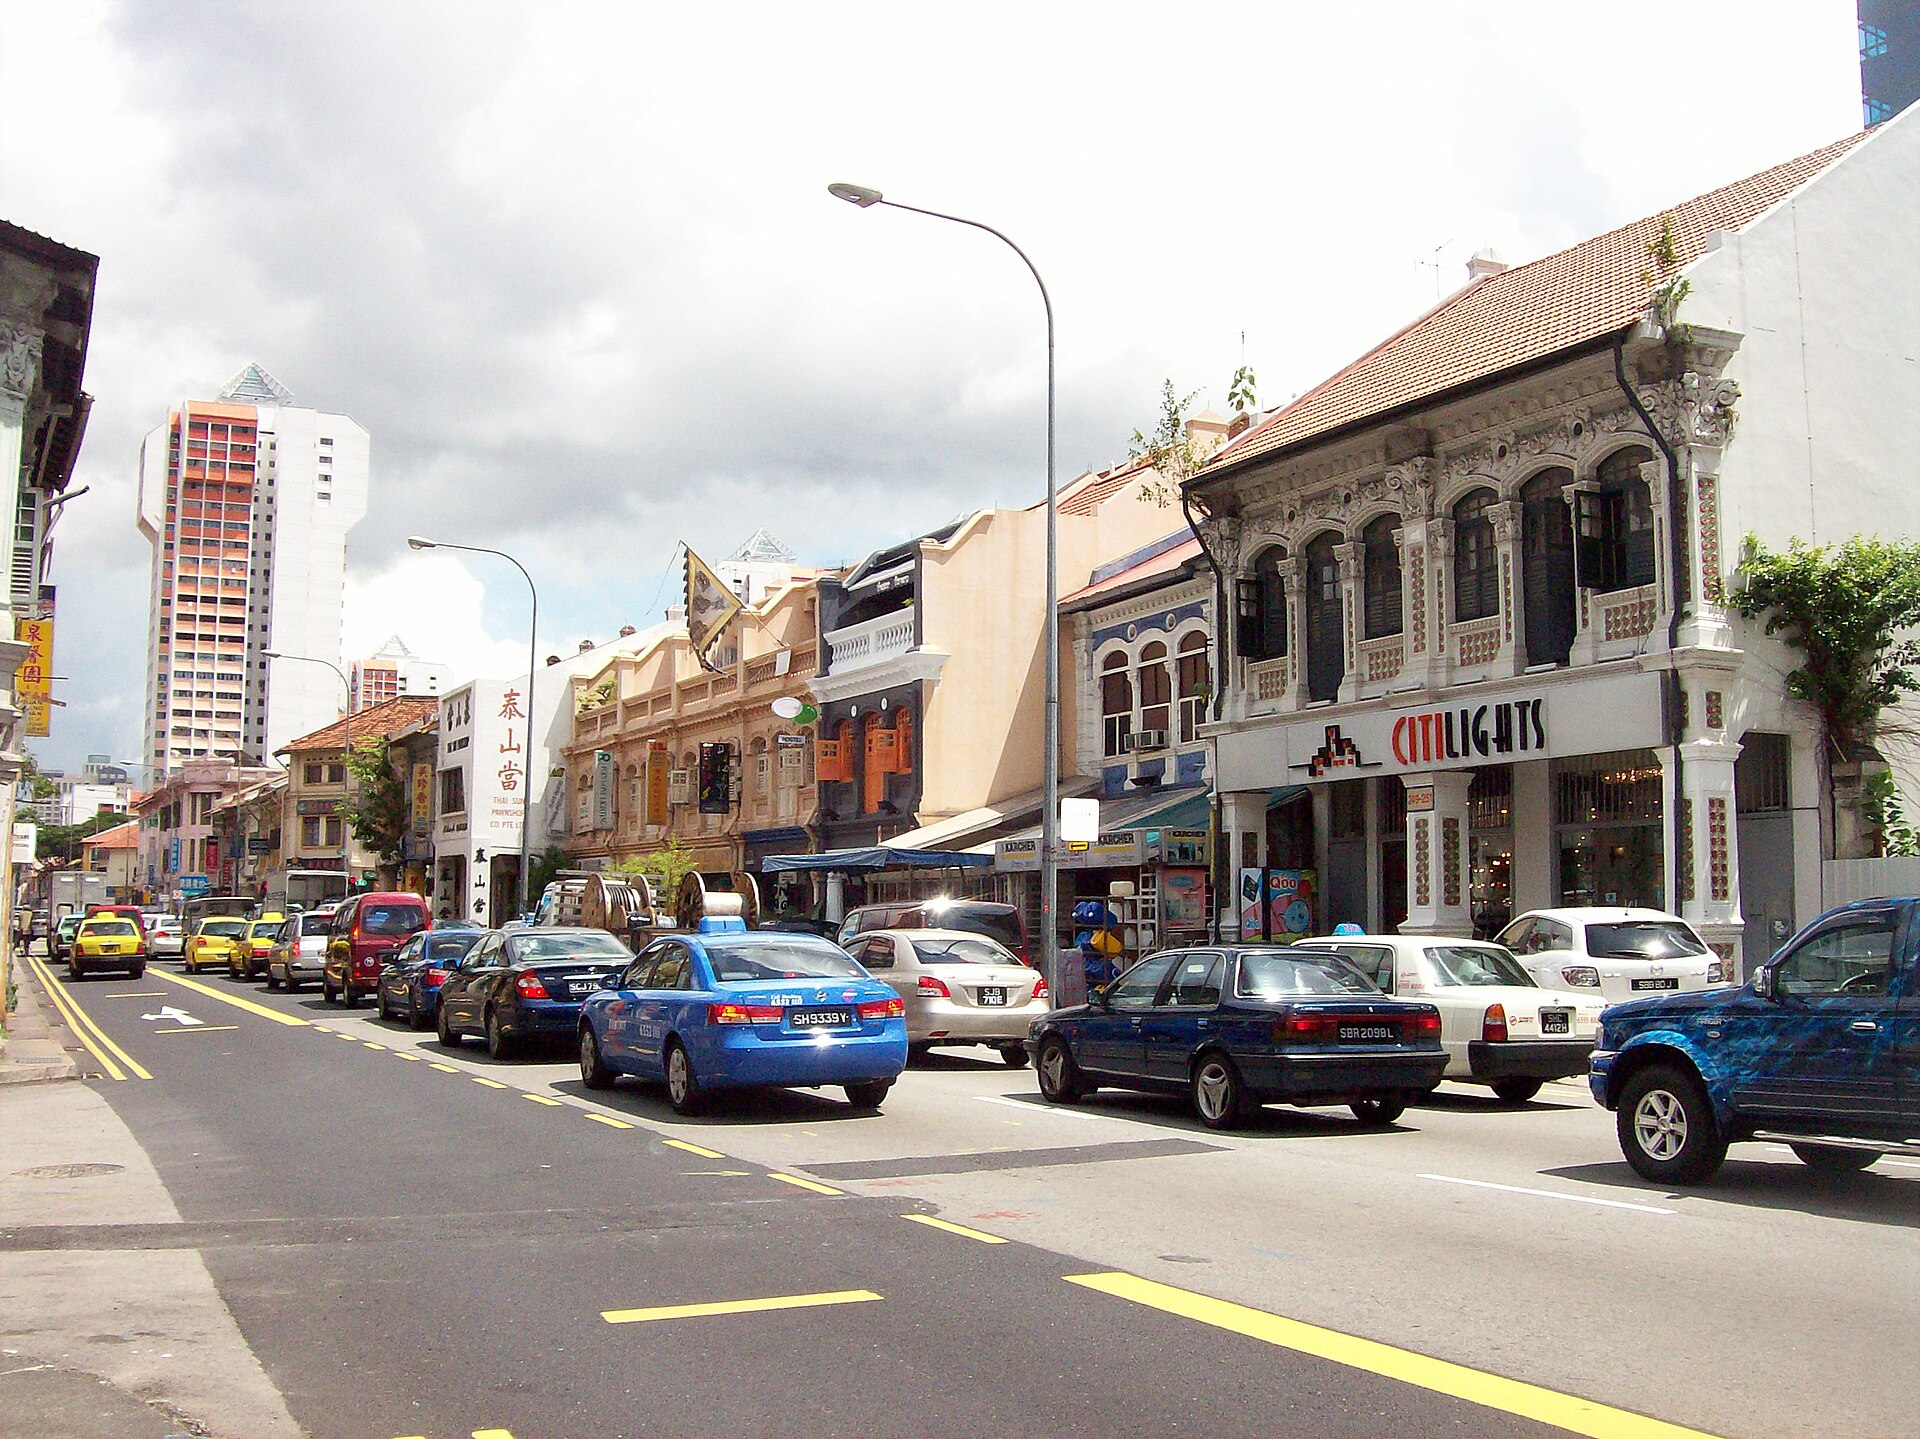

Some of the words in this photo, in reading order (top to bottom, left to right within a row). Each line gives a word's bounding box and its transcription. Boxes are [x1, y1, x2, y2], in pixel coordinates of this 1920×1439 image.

[1392, 699, 1545, 766] CITILIGHTS
[498, 688, 526, 792] 泰山當
[493, 796, 508, 804] THAI
[502, 821, 514, 829] PTE
[473, 847, 488, 914] 泰山當
[793, 1012, 847, 1025] SH9339Y
[1339, 1027, 1395, 1039] SBR2098L
[1544, 1023, 1567, 1033] 4412H
